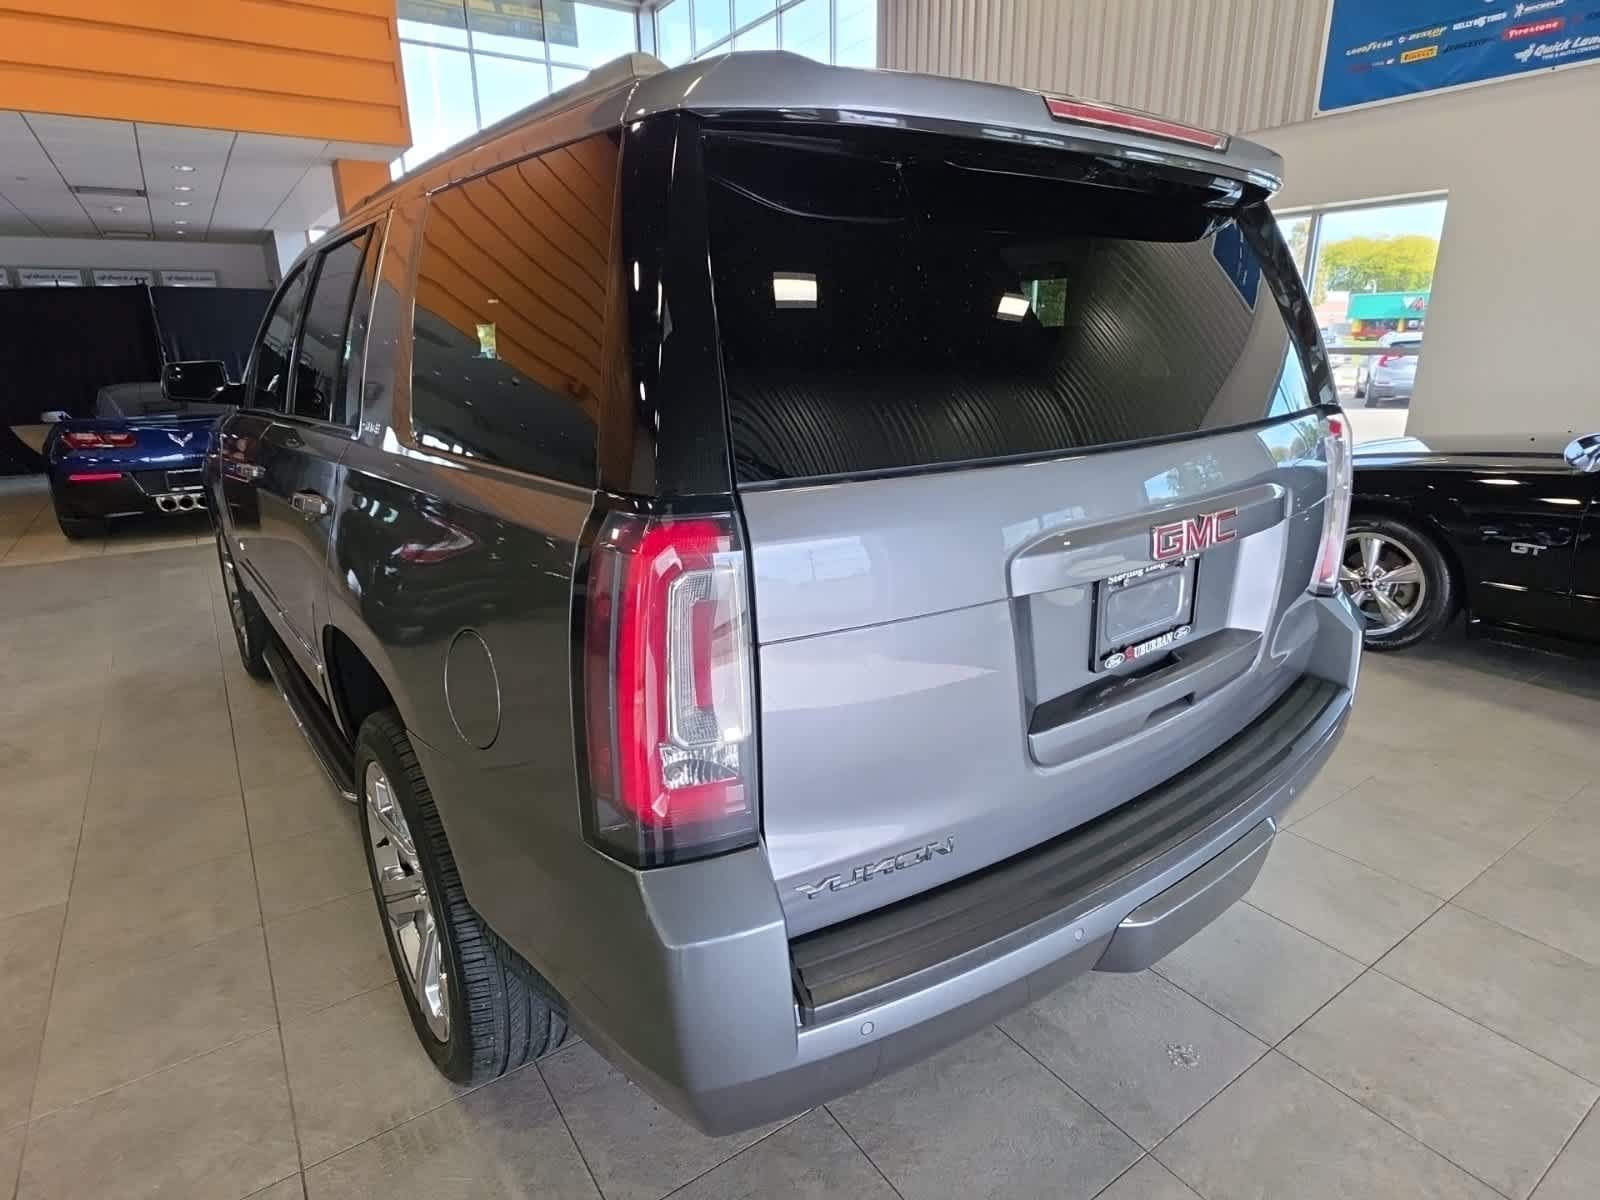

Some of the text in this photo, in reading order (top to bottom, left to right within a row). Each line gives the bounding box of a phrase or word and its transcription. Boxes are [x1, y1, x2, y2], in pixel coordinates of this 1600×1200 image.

[1534, 39, 1571, 57] Quick
[1571, 36, 1600, 48] Lan
[1152, 507, 1238, 561] GMC
[1510, 541, 1547, 556] GT
[795, 834, 954, 899] YUKON
